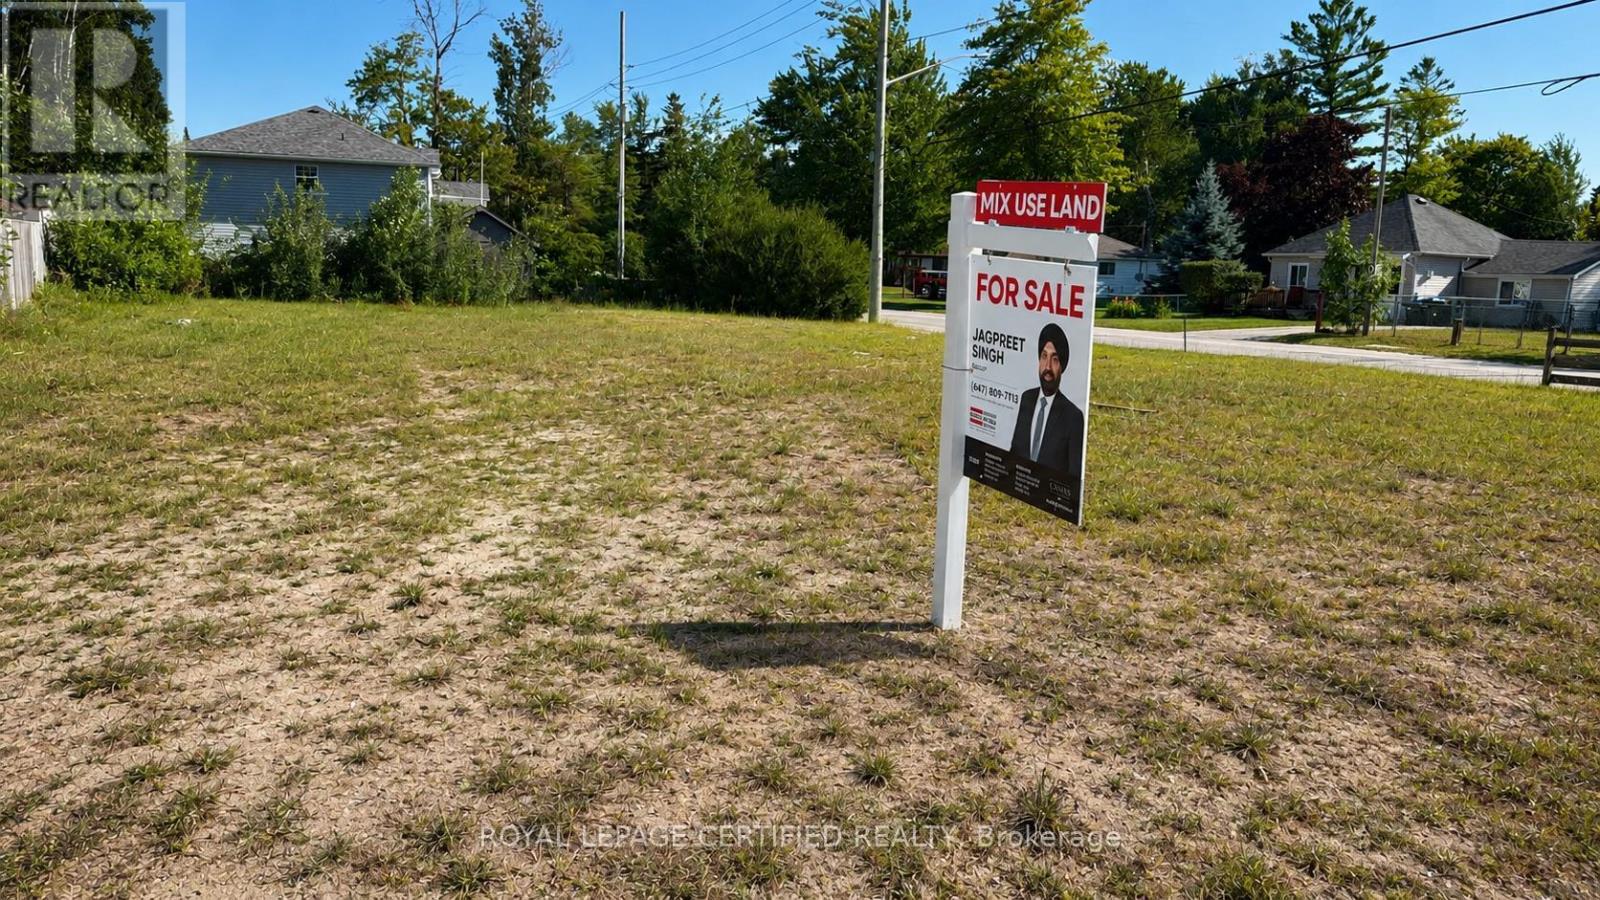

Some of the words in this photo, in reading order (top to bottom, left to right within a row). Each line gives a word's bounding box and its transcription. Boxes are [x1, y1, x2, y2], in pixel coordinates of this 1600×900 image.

[980, 192, 1011, 215] MIX
[1014, 192, 1047, 217] USE
[1050, 194, 1100, 220] LAND
[976, 272, 1019, 307] FOR
[1024, 279, 1085, 319] SALE
[972, 328, 1026, 353] JAGPREET
[972, 344, 1004, 365] SINGH
